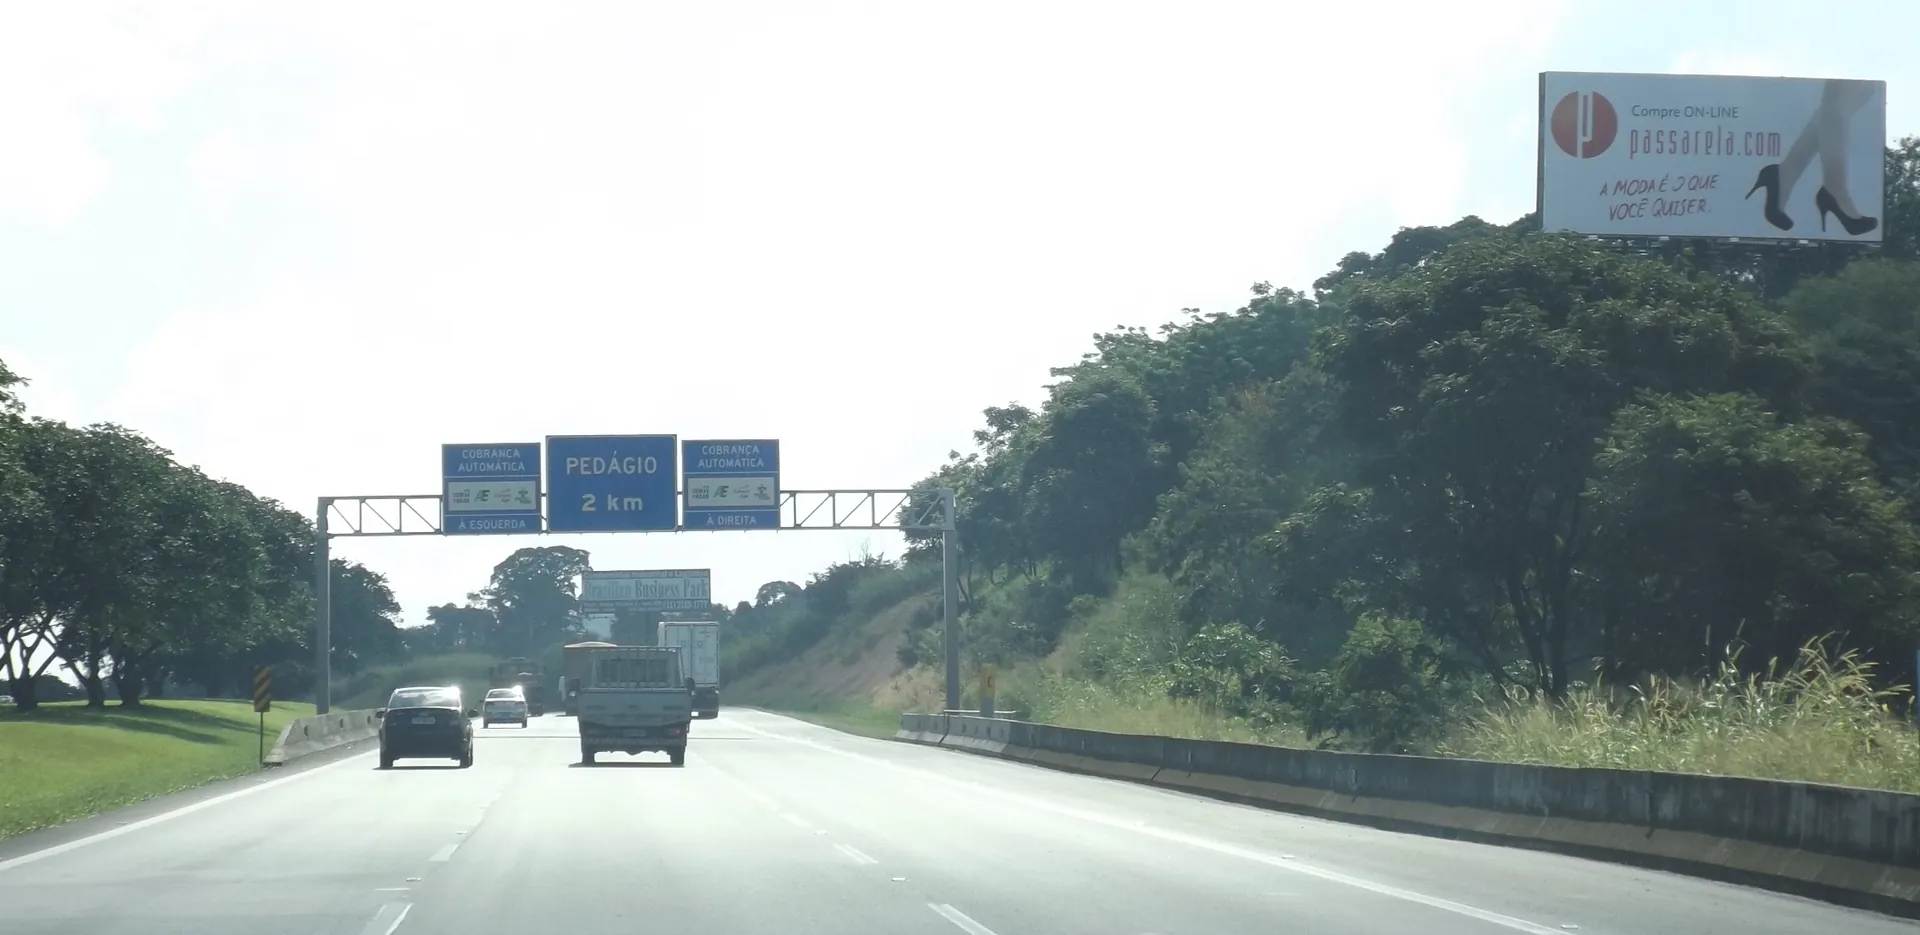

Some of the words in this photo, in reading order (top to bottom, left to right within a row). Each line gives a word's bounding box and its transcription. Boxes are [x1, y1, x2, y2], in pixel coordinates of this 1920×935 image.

[1631, 105, 1681, 119] Compre
[1684, 106, 1739, 119] ON-LINE
[1630, 126, 1782, 160] passarela.com
[1599, 183, 1608, 196] A
[1613, 179, 1656, 197] MODA
[1658, 173, 1669, 193] É
[1687, 174, 1719, 191] QUE
[1609, 198, 1649, 221] VOCÊ
[462, 448, 520, 459] COBRANÇA
[702, 445, 760, 457] COBRANÇA
[458, 459, 525, 472] AUTOMÁTICA
[566, 451, 657, 475] PEDÁGIO
[698, 456, 764, 468] AUTOMÁTICA
[581, 494, 597, 512] 2
[607, 494, 644, 511] km
[470, 519, 526, 529] ESQUERDA
[717, 516, 757, 525] DIREITA
[635, 580, 681, 598] Business
[684, 579, 709, 597] Park
